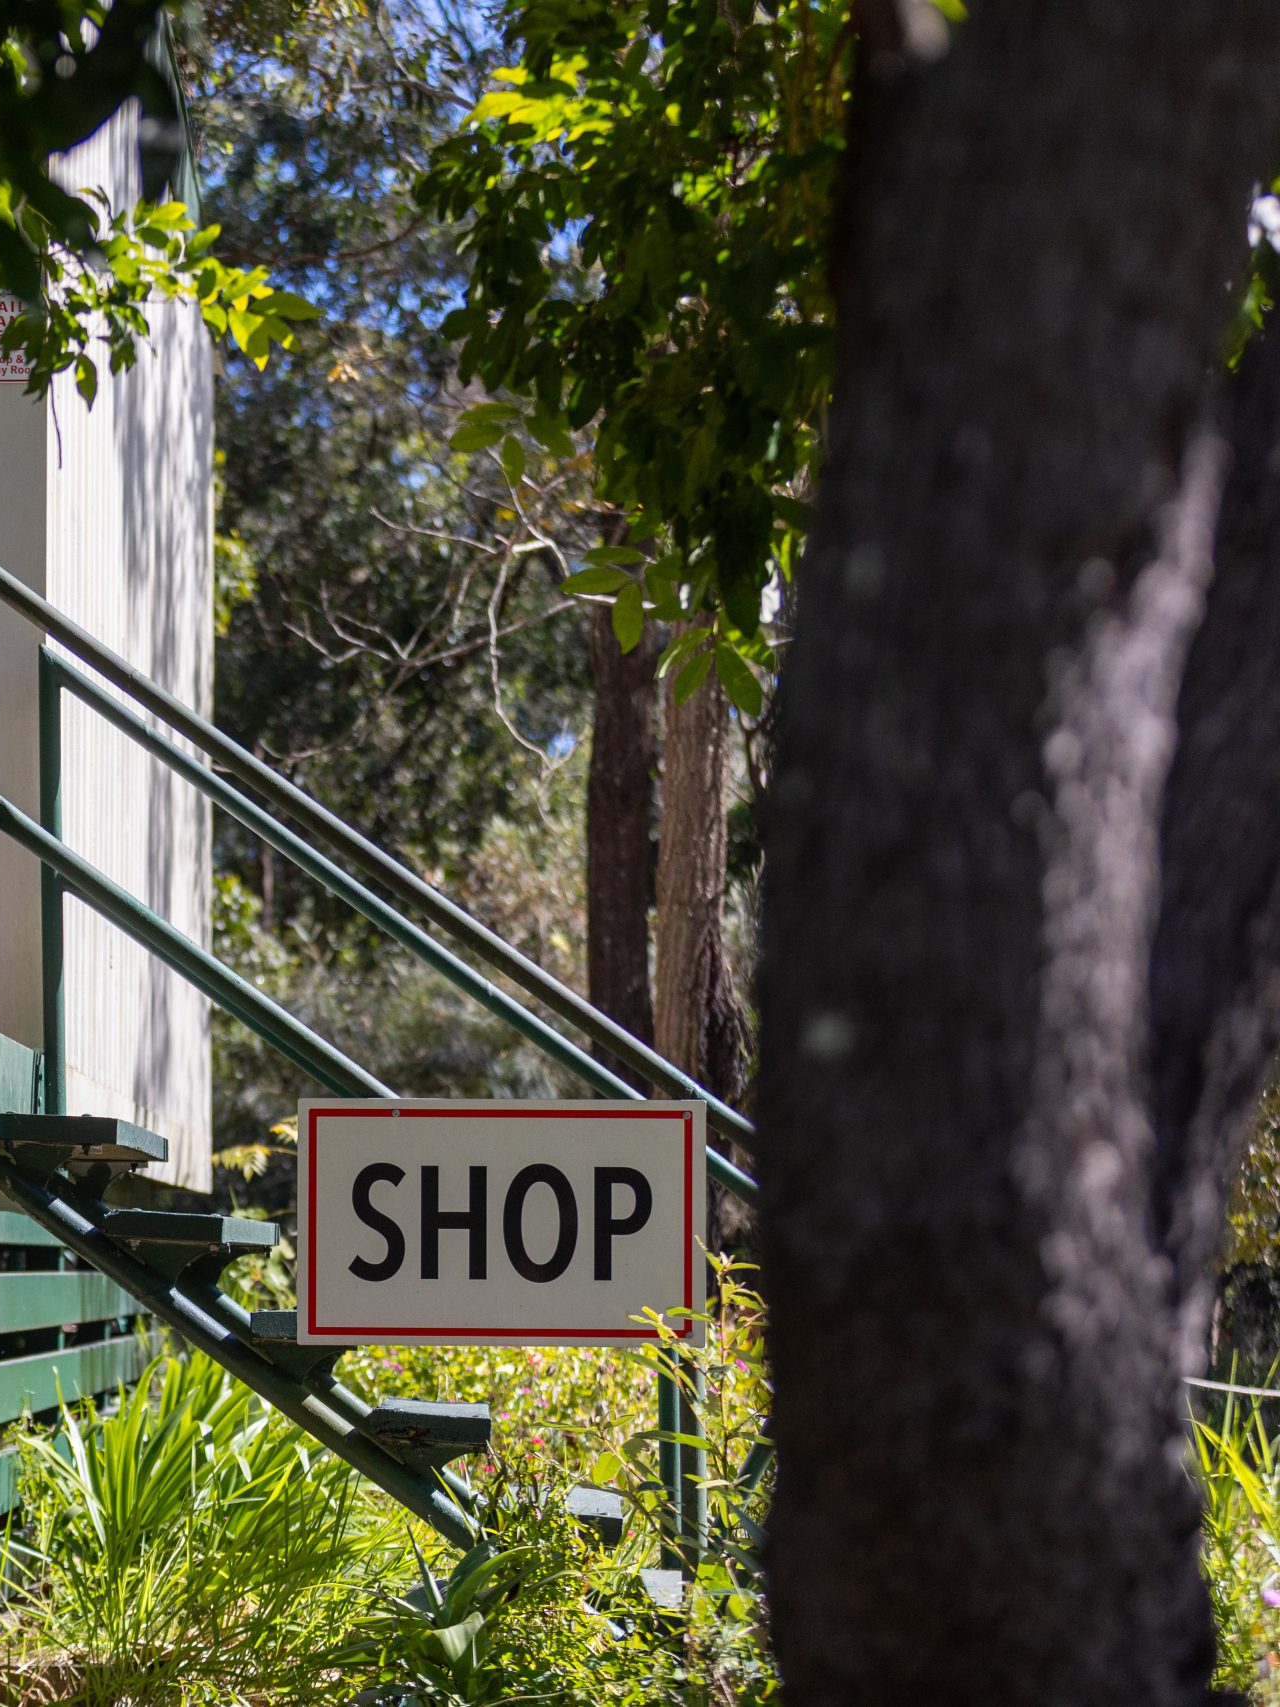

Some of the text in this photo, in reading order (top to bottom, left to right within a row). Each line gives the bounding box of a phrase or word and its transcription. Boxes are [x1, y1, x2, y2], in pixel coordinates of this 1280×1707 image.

[15, 354, 24, 364] &
[10, 365, 32, 375] Roo
[348, 1162, 653, 1283] SHOP
